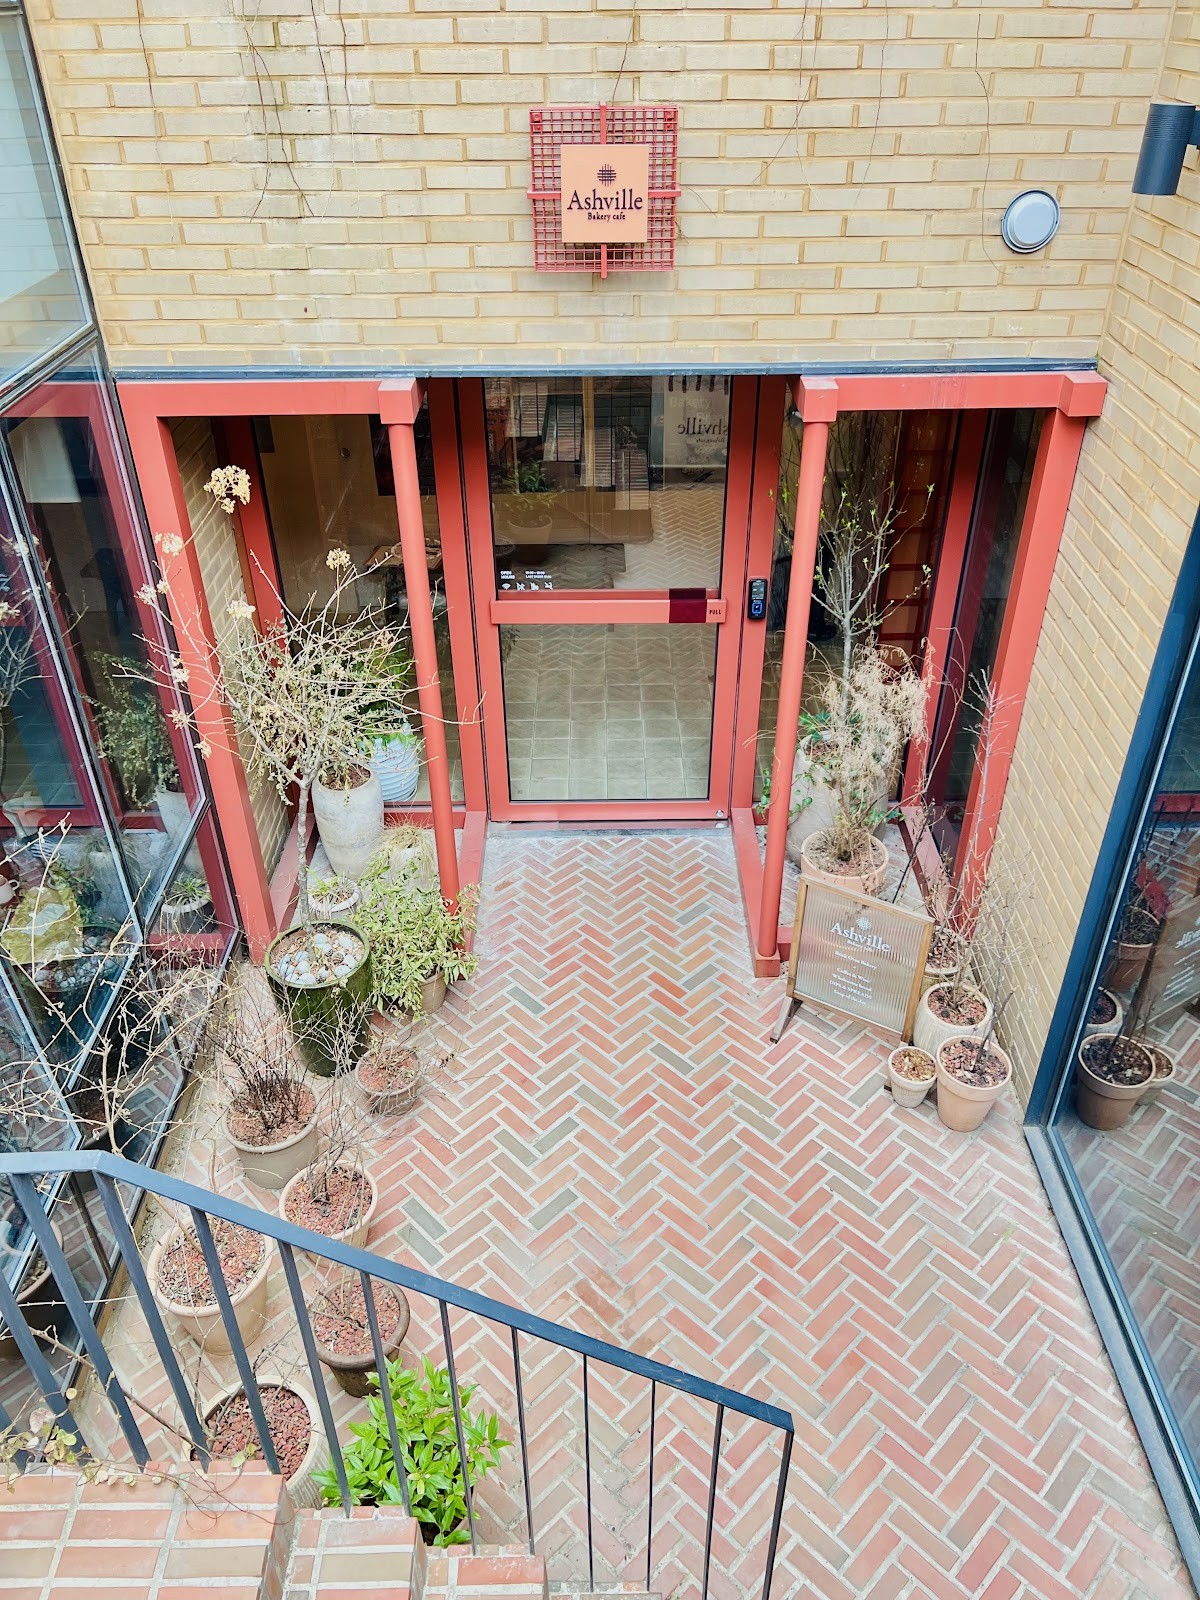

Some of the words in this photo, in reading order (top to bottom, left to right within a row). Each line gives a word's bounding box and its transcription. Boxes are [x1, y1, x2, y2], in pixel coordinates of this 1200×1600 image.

[567, 188, 643, 210] Ashville
[587, 212, 611, 222] Bakery
[612, 212, 626, 220] cafe
[830, 922, 890, 952] Ashville
